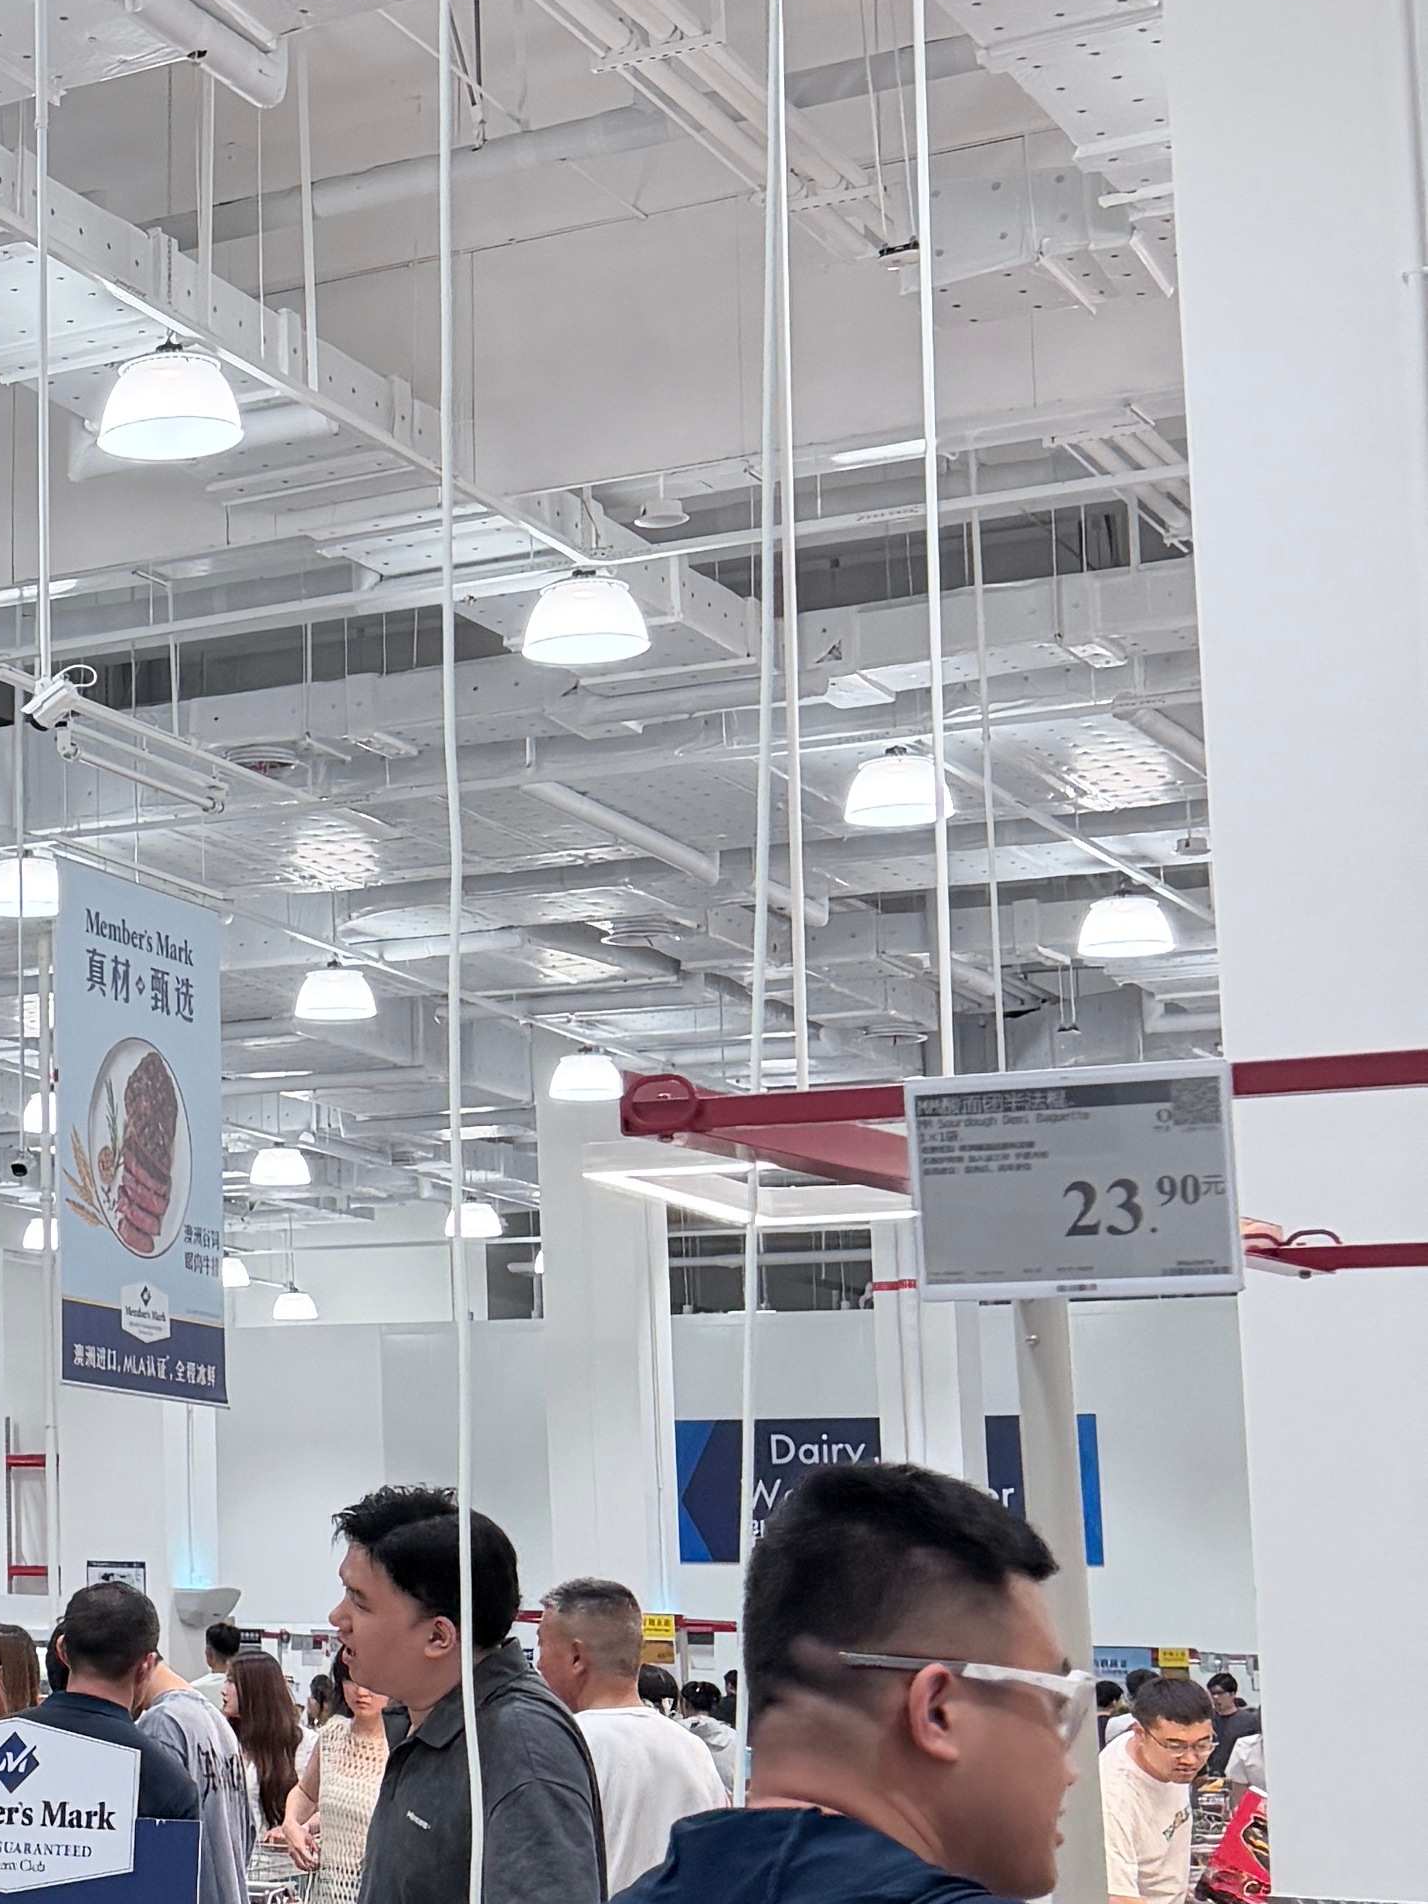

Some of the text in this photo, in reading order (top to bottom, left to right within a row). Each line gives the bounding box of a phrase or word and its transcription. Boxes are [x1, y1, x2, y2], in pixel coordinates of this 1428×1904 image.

[85, 907, 194, 967] Member's Mark
[86, 948, 194, 1023] 真材 甄选
[40, 1800, 116, 1831] Mark
